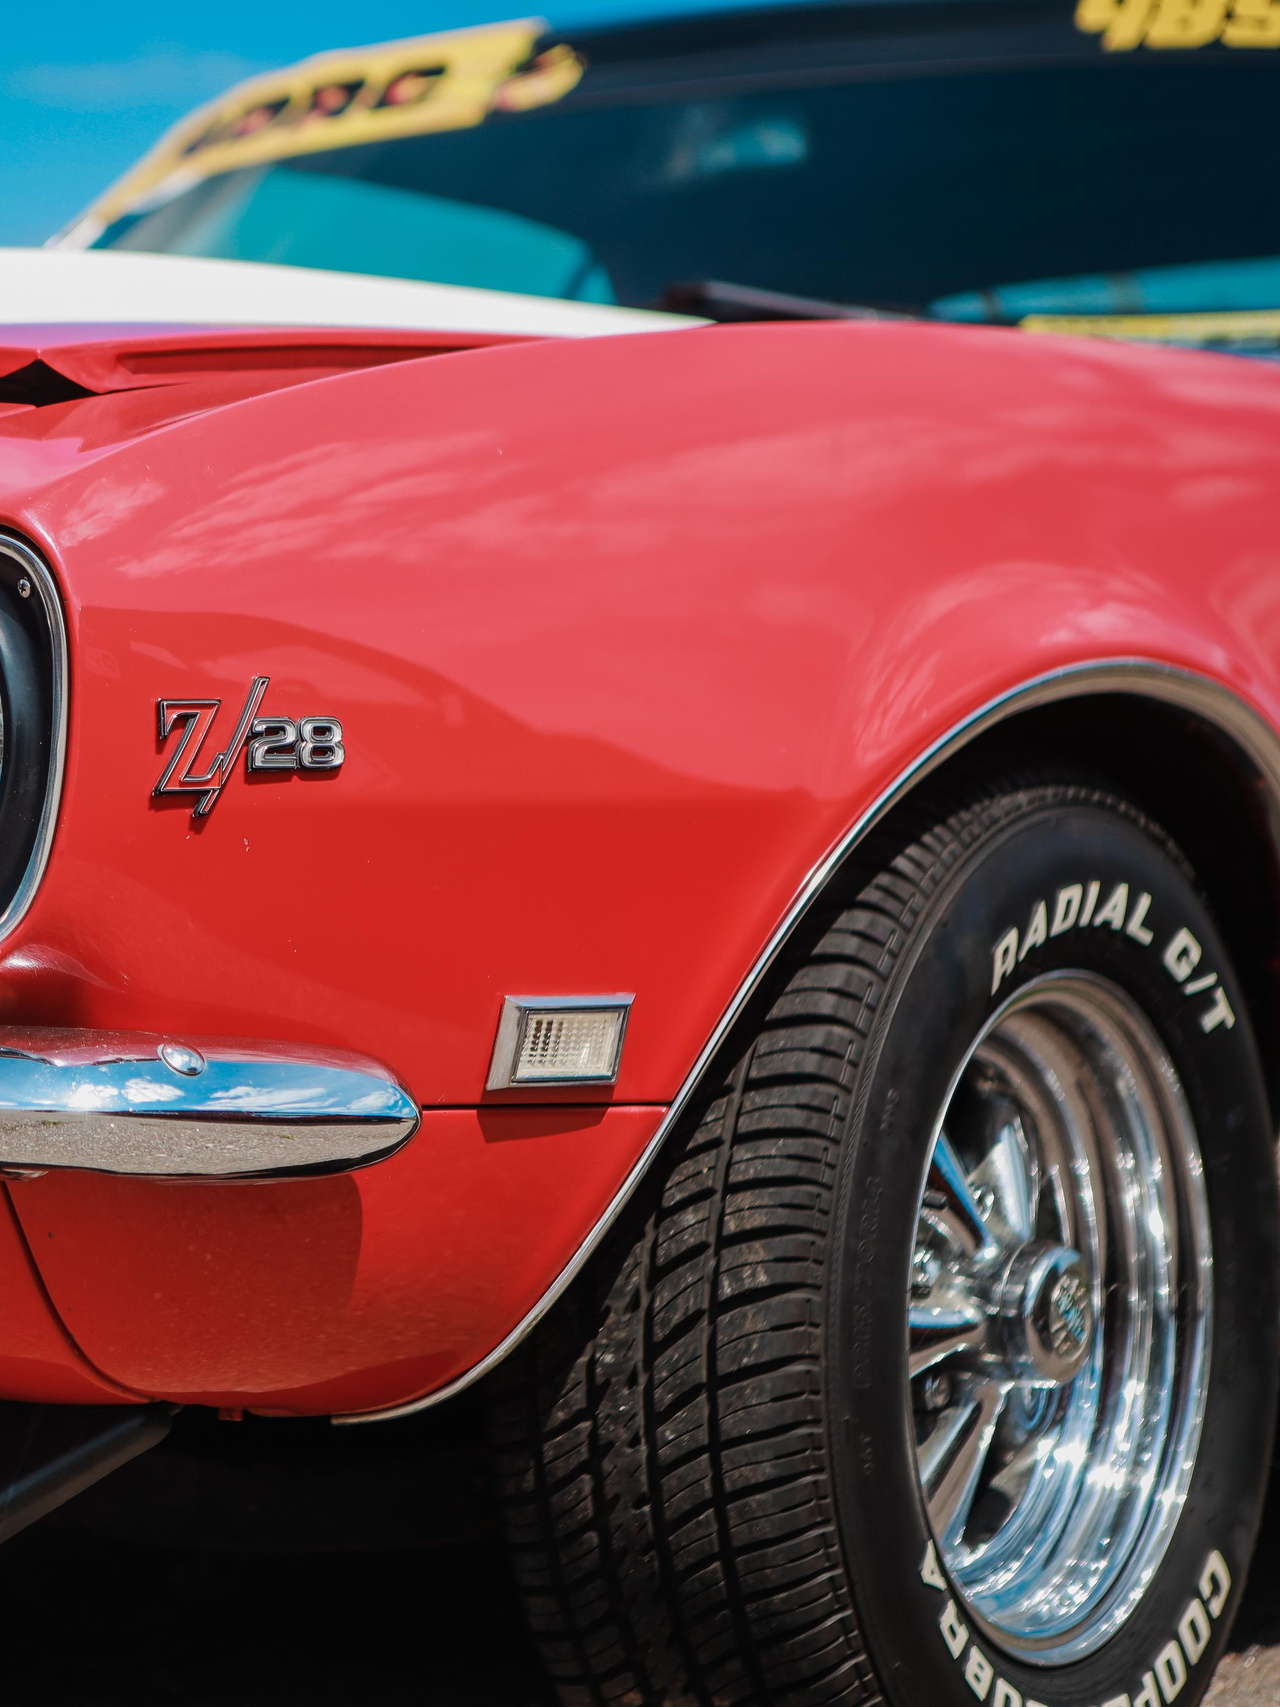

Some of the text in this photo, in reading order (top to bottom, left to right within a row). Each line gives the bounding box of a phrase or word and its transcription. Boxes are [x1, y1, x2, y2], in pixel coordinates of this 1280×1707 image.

[152, 676, 345, 817] Z/28
[991, 880, 1154, 996] RADIAL
[920, 1539, 1232, 1707] COOP OBRA
